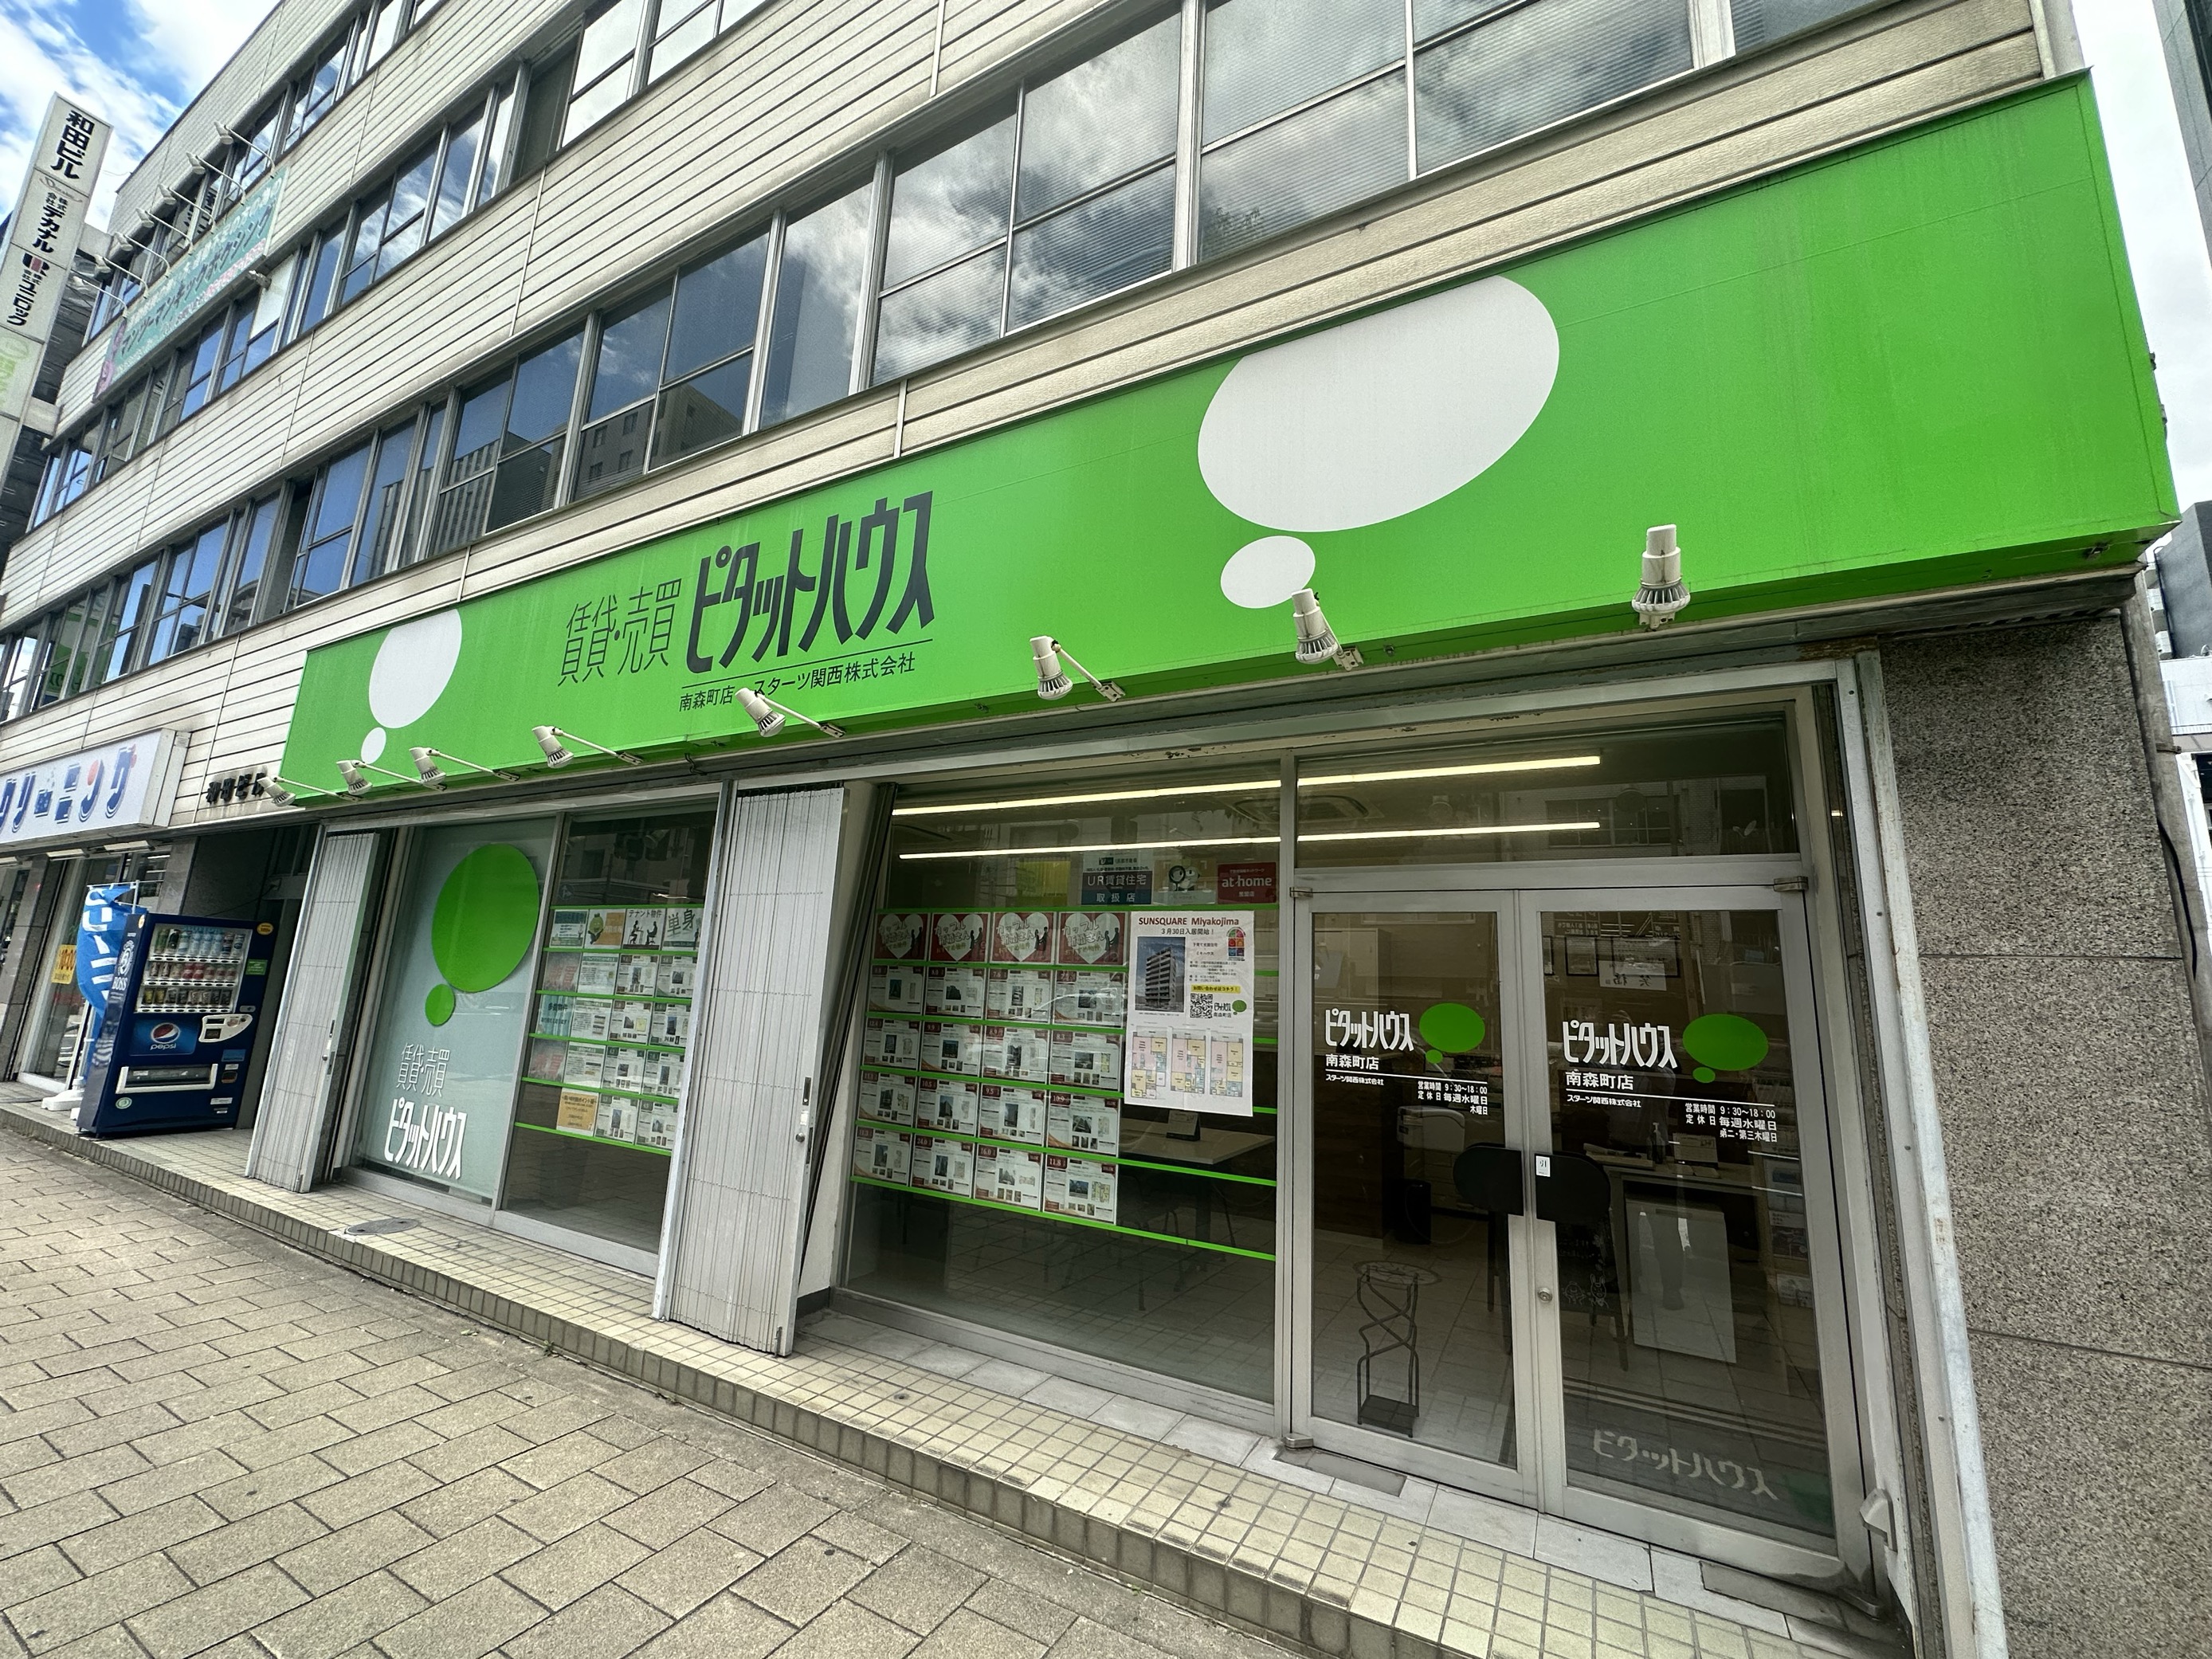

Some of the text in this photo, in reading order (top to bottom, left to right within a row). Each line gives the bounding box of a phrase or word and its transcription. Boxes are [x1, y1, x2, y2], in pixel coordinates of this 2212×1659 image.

[50, 110, 95, 179] 和田ビル
[686, 490, 935, 674] ピタットハウス
[558, 578, 682, 686] 賃貸・売買
[679, 652, 916, 712] 南森町店 スターツ関西株式会社
[1088, 874, 1147, 886] UR賃貸住宅
[1222, 875, 1273, 888] at home
[1096, 892, 1135, 903] 取扱店
[629, 909, 662, 918] テナント物件
[667, 908, 695, 935] 単身
[1191, 917, 1239, 927] Miyakojima
[1325, 1007, 1414, 1052] ピタットハウス
[1563, 1019, 1678, 1069] ピタットハウス
[1325, 1053, 1379, 1071] 南森町店
[1325, 1074, 1384, 1086] スターツ関西株式会社
[1418, 1081, 1441, 1092] 営業時間
[1565, 1070, 1634, 1090] 南森町店
[1418, 1090, 1488, 1105] 定休日 毎週水曜日
[1567, 1094, 1641, 1108] スターツ関西株式会社
[1469, 1105, 1488, 1115] 木曜日
[1684, 1102, 1716, 1115] 営業時間
[1685, 1114, 1777, 1131] 定休日 毎週水曜日
[384, 1096, 468, 1180] ピタットハウス
